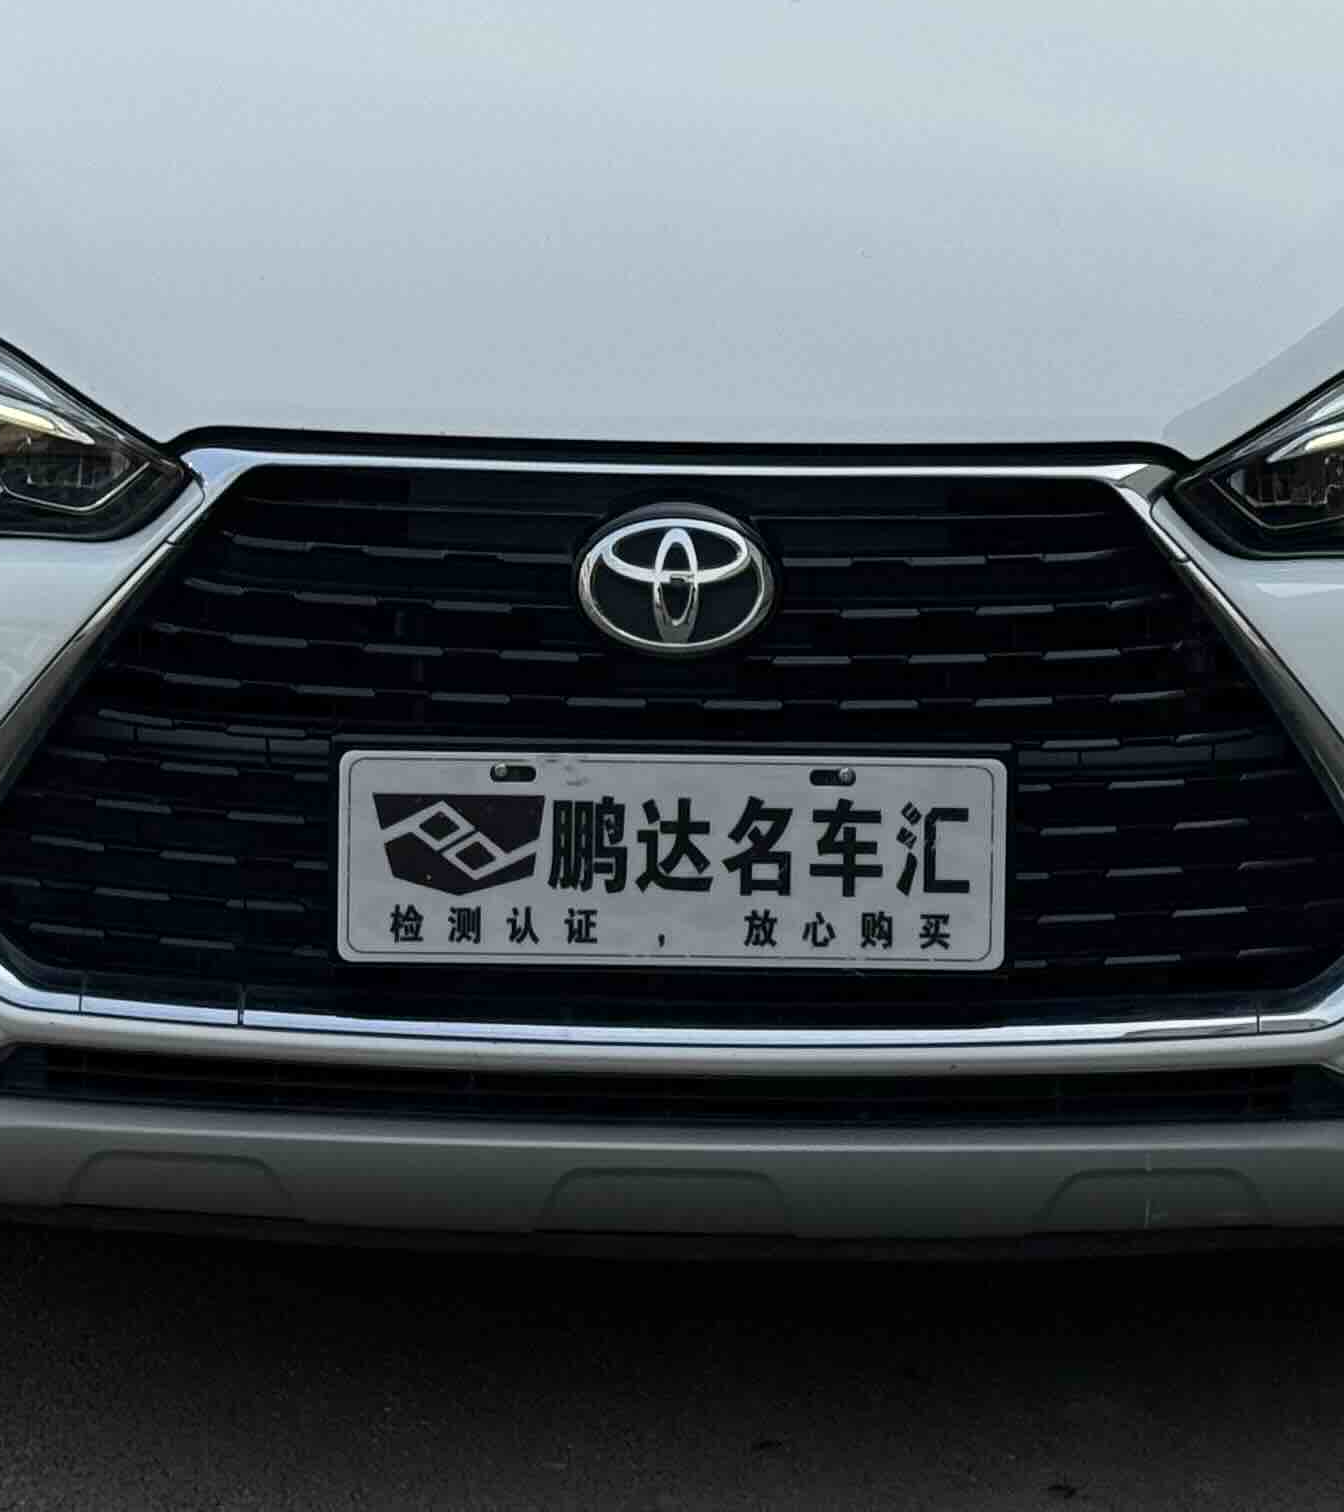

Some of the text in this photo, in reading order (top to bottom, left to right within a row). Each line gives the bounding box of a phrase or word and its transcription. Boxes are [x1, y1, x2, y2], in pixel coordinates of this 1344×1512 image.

[545, 795, 971, 899] 鹏达名车汇
